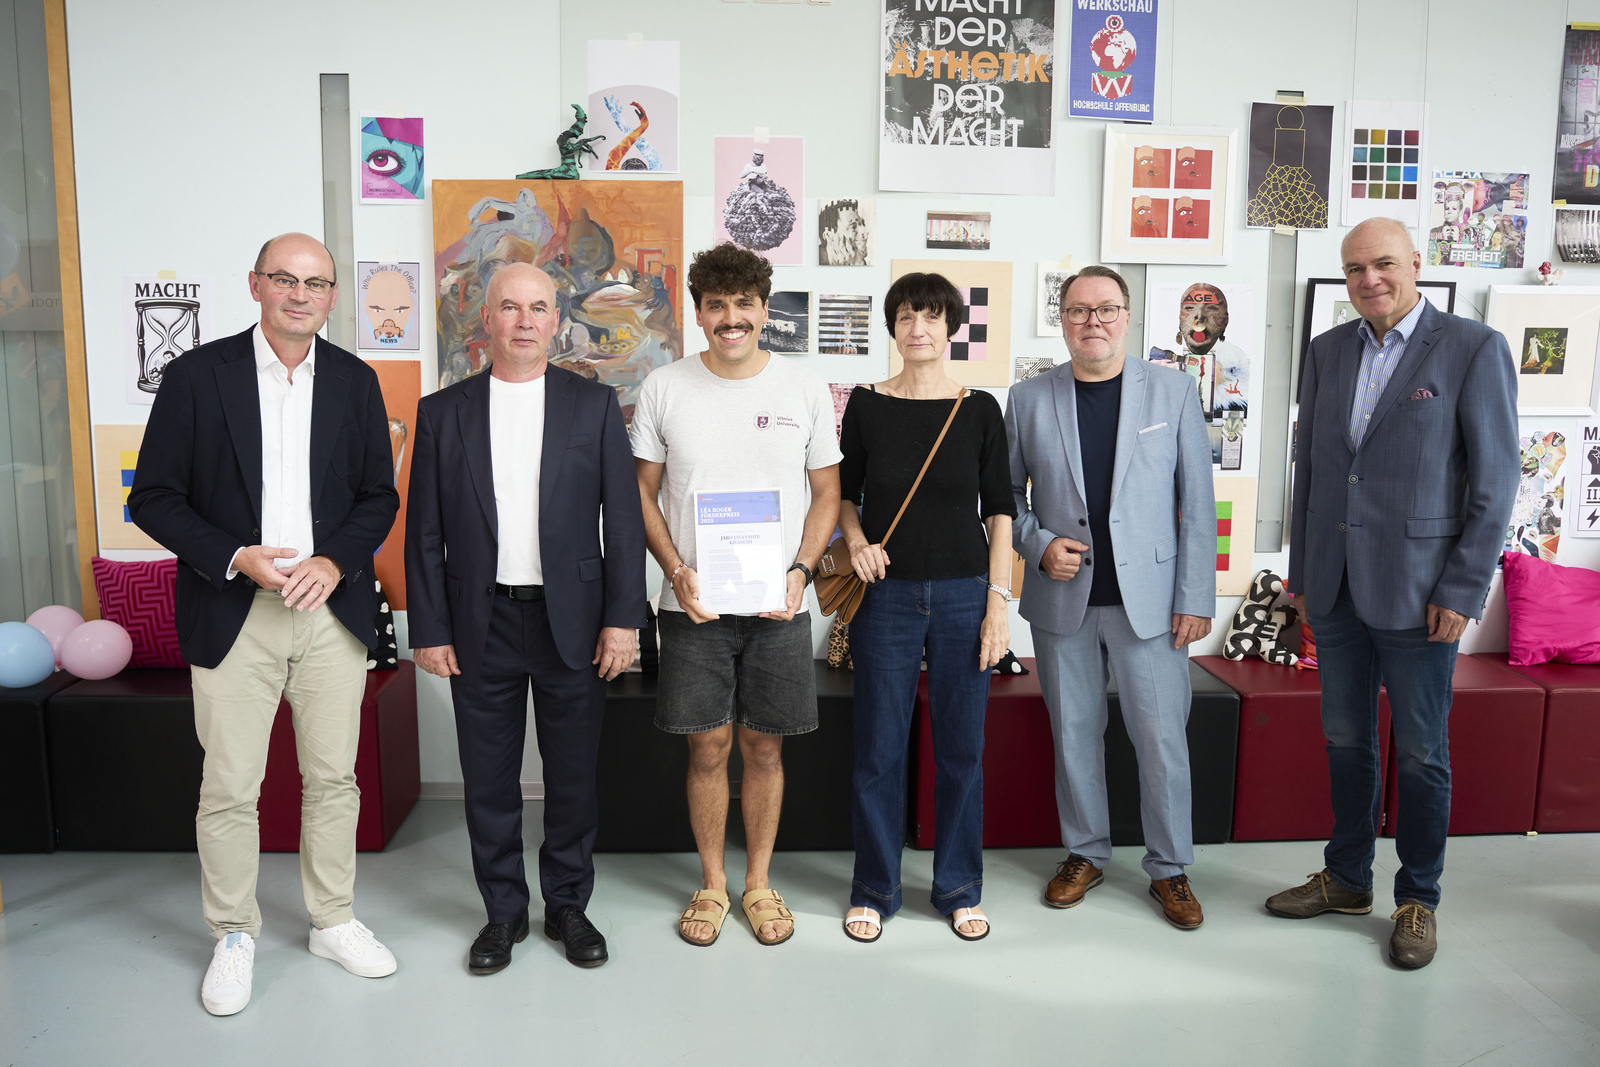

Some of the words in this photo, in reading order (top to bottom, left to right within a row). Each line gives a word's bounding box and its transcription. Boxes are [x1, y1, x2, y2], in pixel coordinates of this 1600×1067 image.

[1077, 0, 1153, 13] WERKSCHAU
[1073, 100, 1114, 111] HOCHSCHULE
[1114, 102, 1151, 113] OFFENBURG
[912, 116, 1025, 148] MACHT
[1450, 249, 1502, 263] FREIHEIT
[361, 275, 373, 291] Who
[369, 265, 389, 276] Rules
[390, 264, 403, 274] The
[402, 270, 417, 295] Office?
[134, 282, 201, 299] MACHT
[1183, 293, 1213, 303] AGE
[776, 421, 800, 429] University
[700, 511, 740, 519] FÖRDERPREIS
